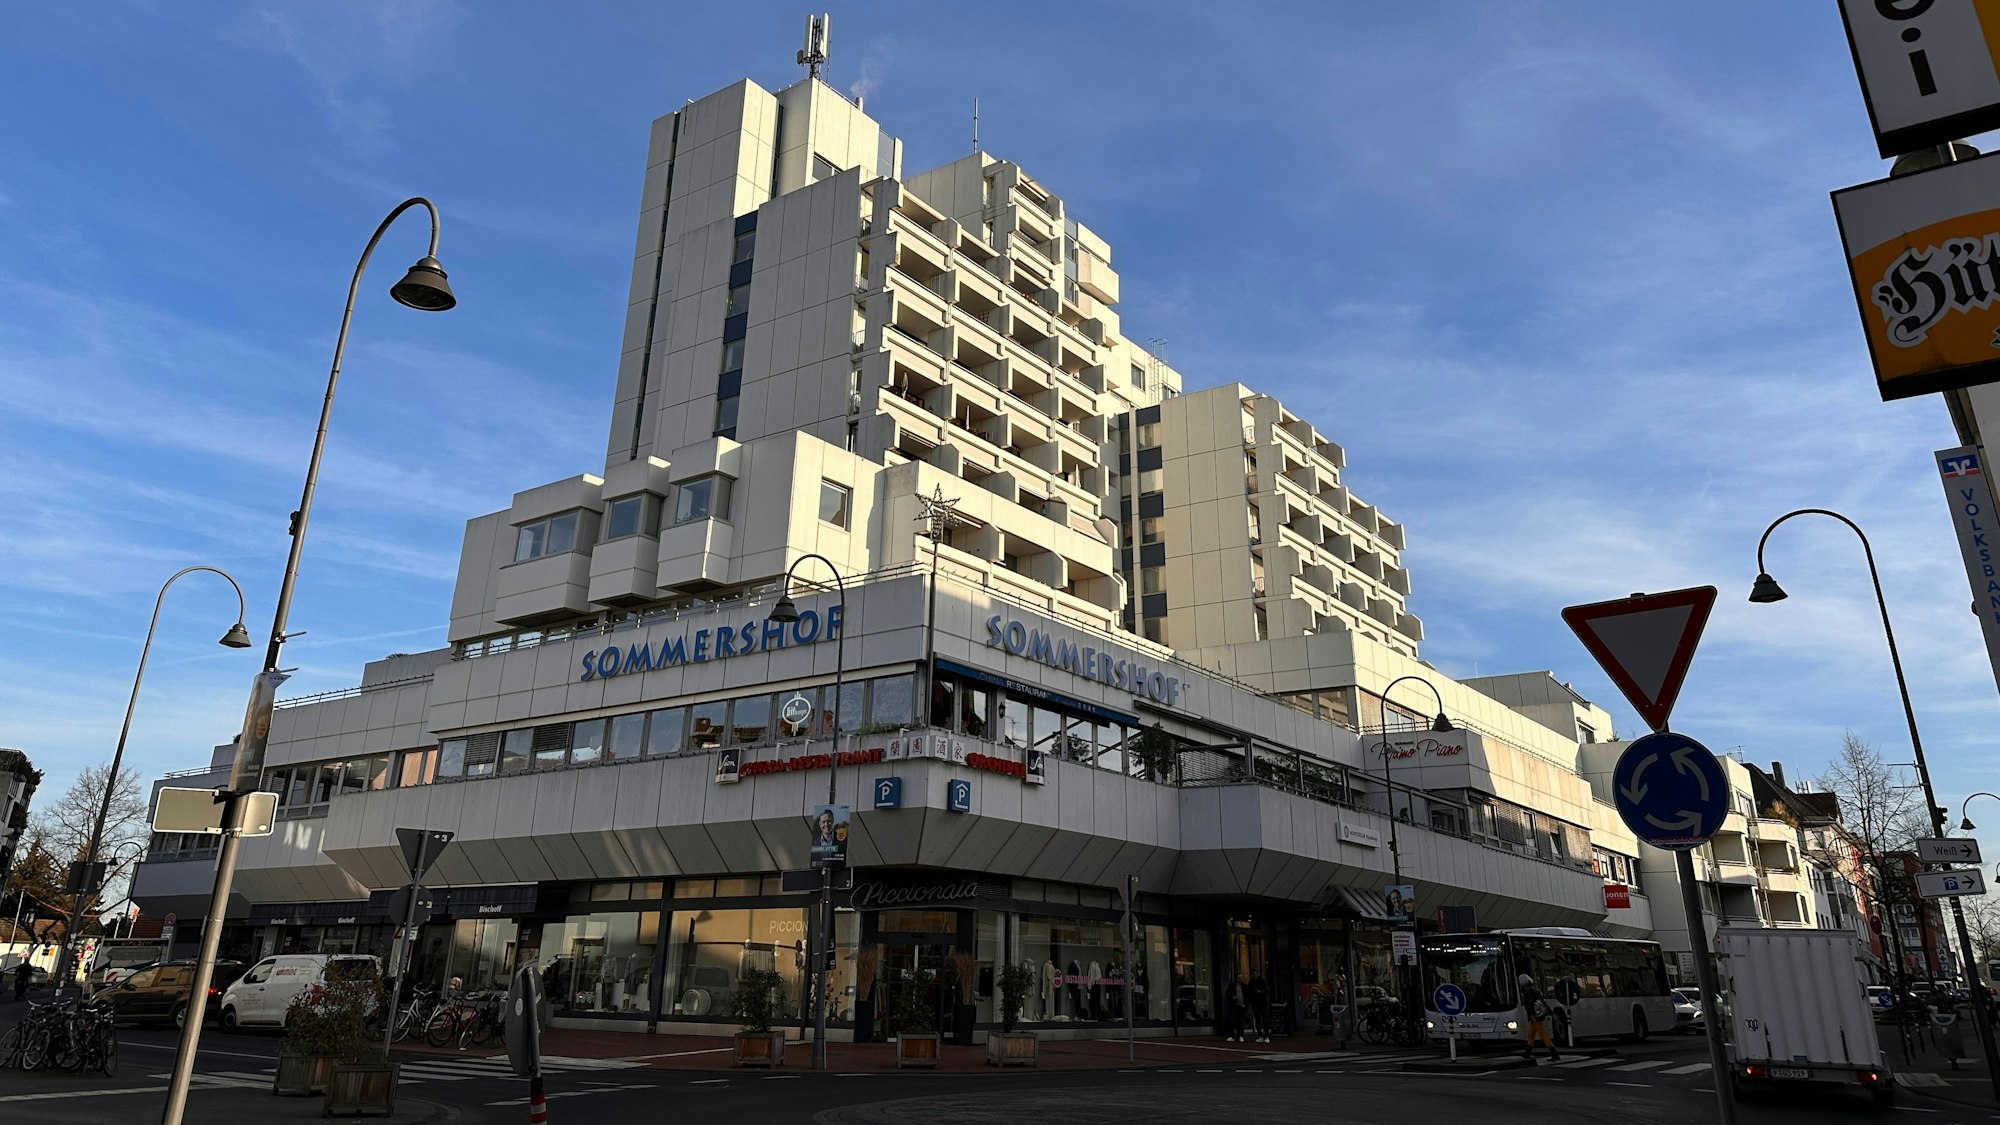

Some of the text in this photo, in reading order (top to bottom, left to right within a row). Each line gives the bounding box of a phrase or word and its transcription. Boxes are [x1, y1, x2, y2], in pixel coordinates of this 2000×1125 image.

[580, 604, 842, 682] SOMMERSHOF
[986, 614, 1180, 706] SOMMERSHOF
[1417, 738, 1463, 757] Piano
[1934, 845, 1957, 856] Weiß
[479, 904, 503, 913] Bischoff
